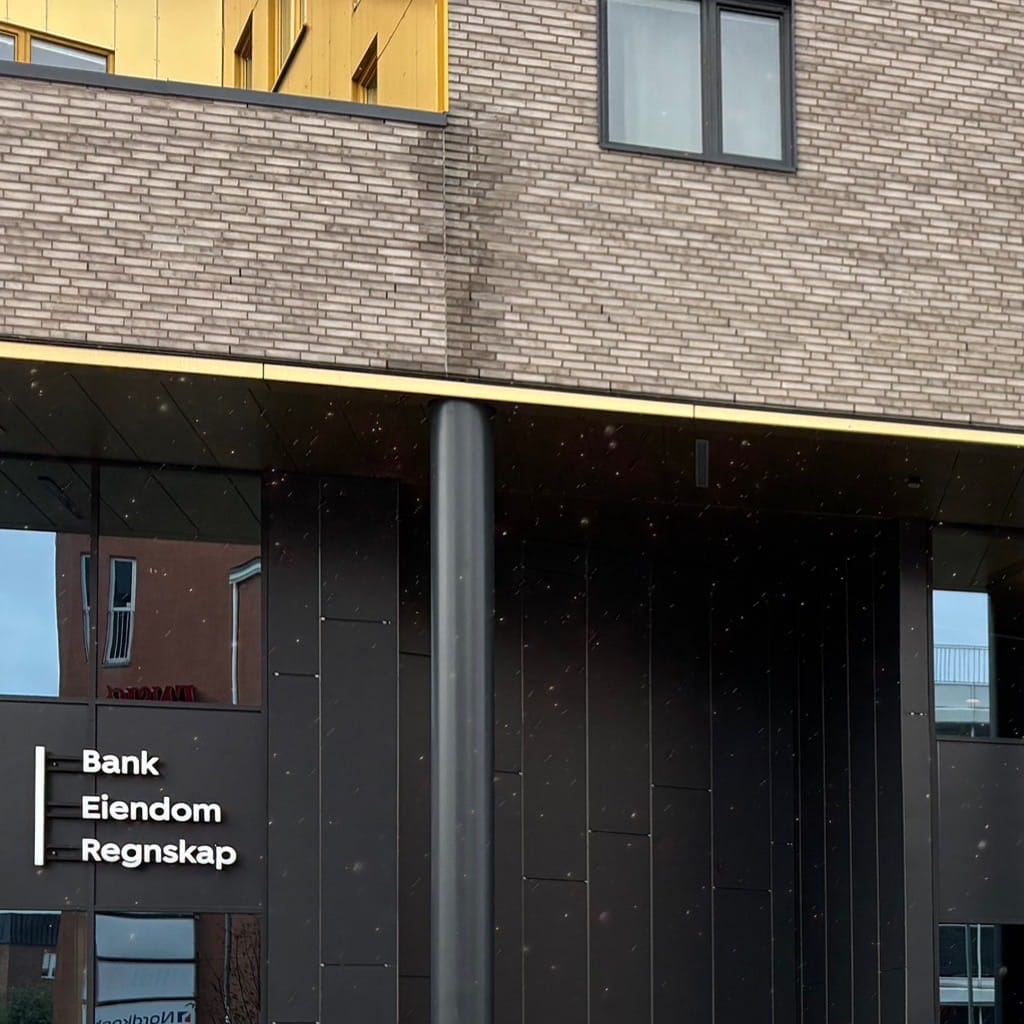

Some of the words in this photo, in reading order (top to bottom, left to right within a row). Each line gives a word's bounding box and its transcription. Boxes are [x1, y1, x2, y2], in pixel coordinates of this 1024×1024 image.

[82, 749, 160, 776] Bank
[82, 793, 222, 823] Eiendom
[82, 838, 237, 871] Regnskap
